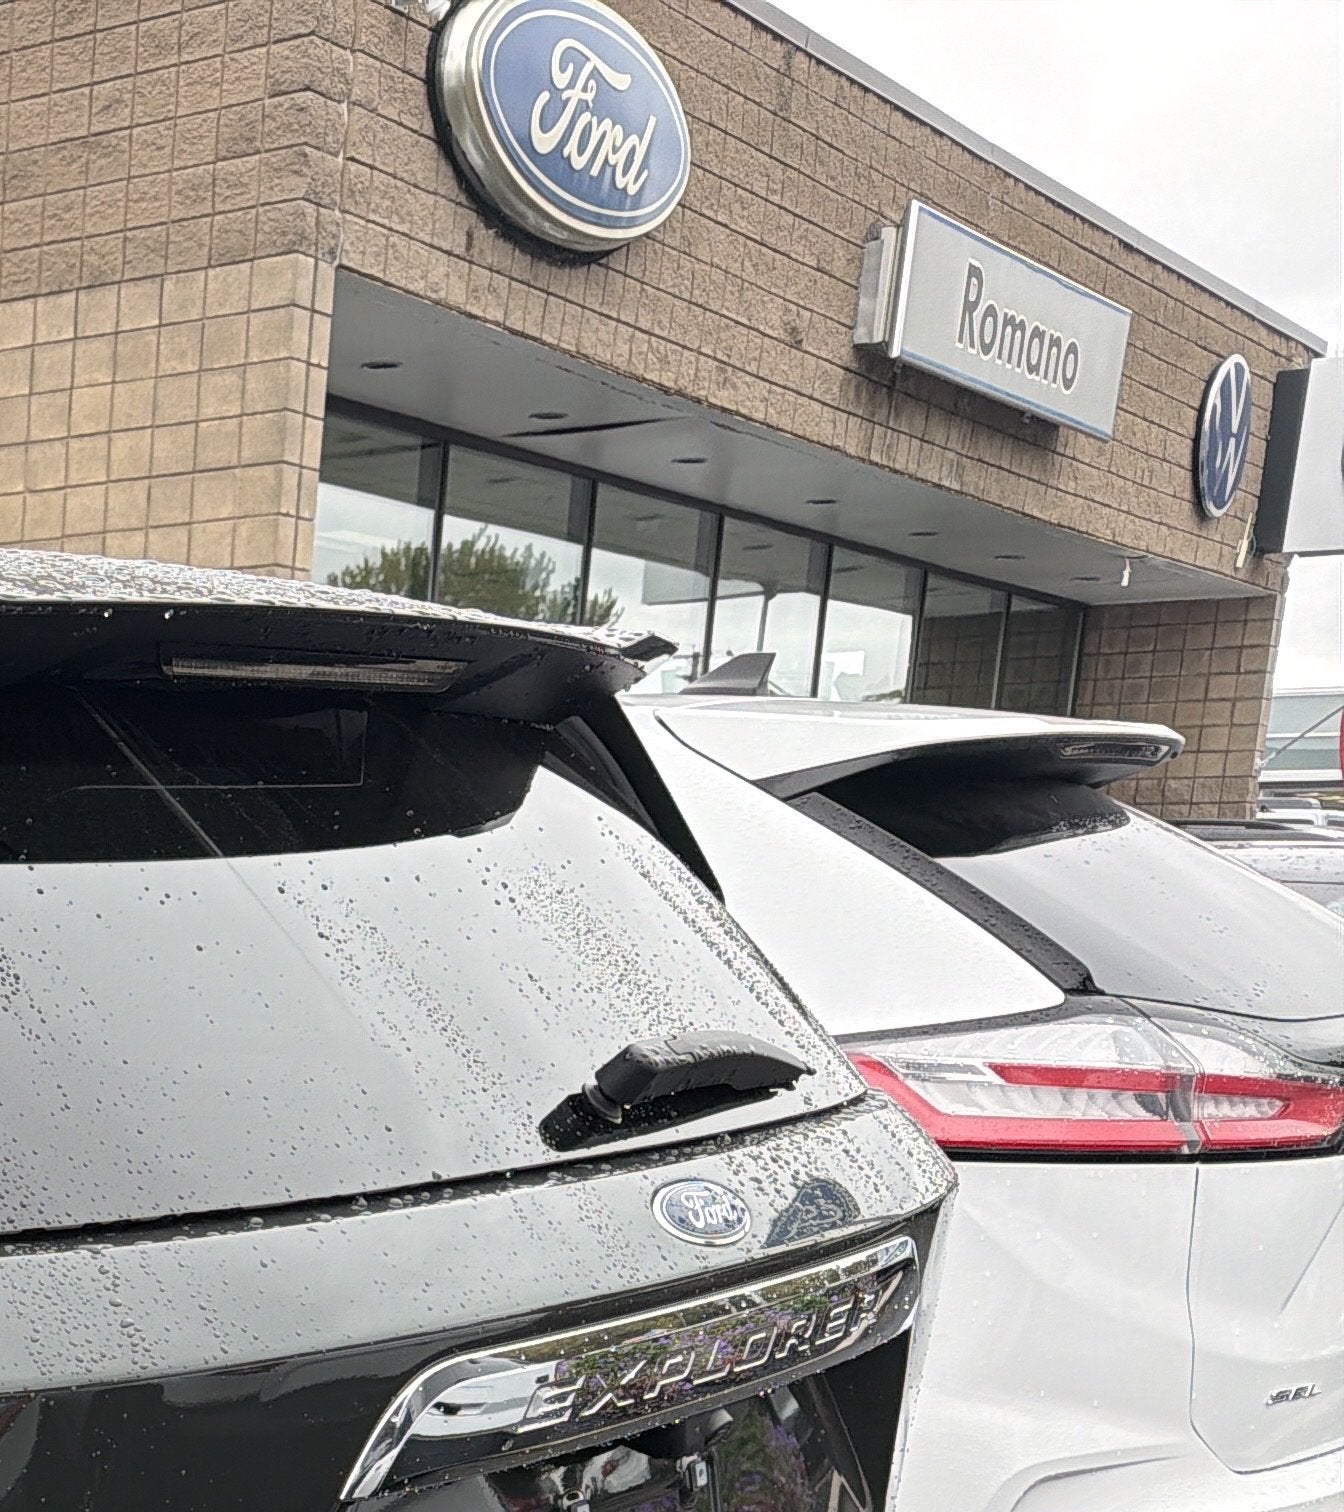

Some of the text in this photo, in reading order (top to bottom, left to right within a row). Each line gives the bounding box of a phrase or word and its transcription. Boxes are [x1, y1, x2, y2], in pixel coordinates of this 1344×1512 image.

[530, 38, 657, 196] Ford
[956, 259, 1080, 394] Romano
[680, 1190, 738, 1229] Ford
[515, 1286, 886, 1435] EXPLORER
[1265, 1383, 1322, 1407] SEL
